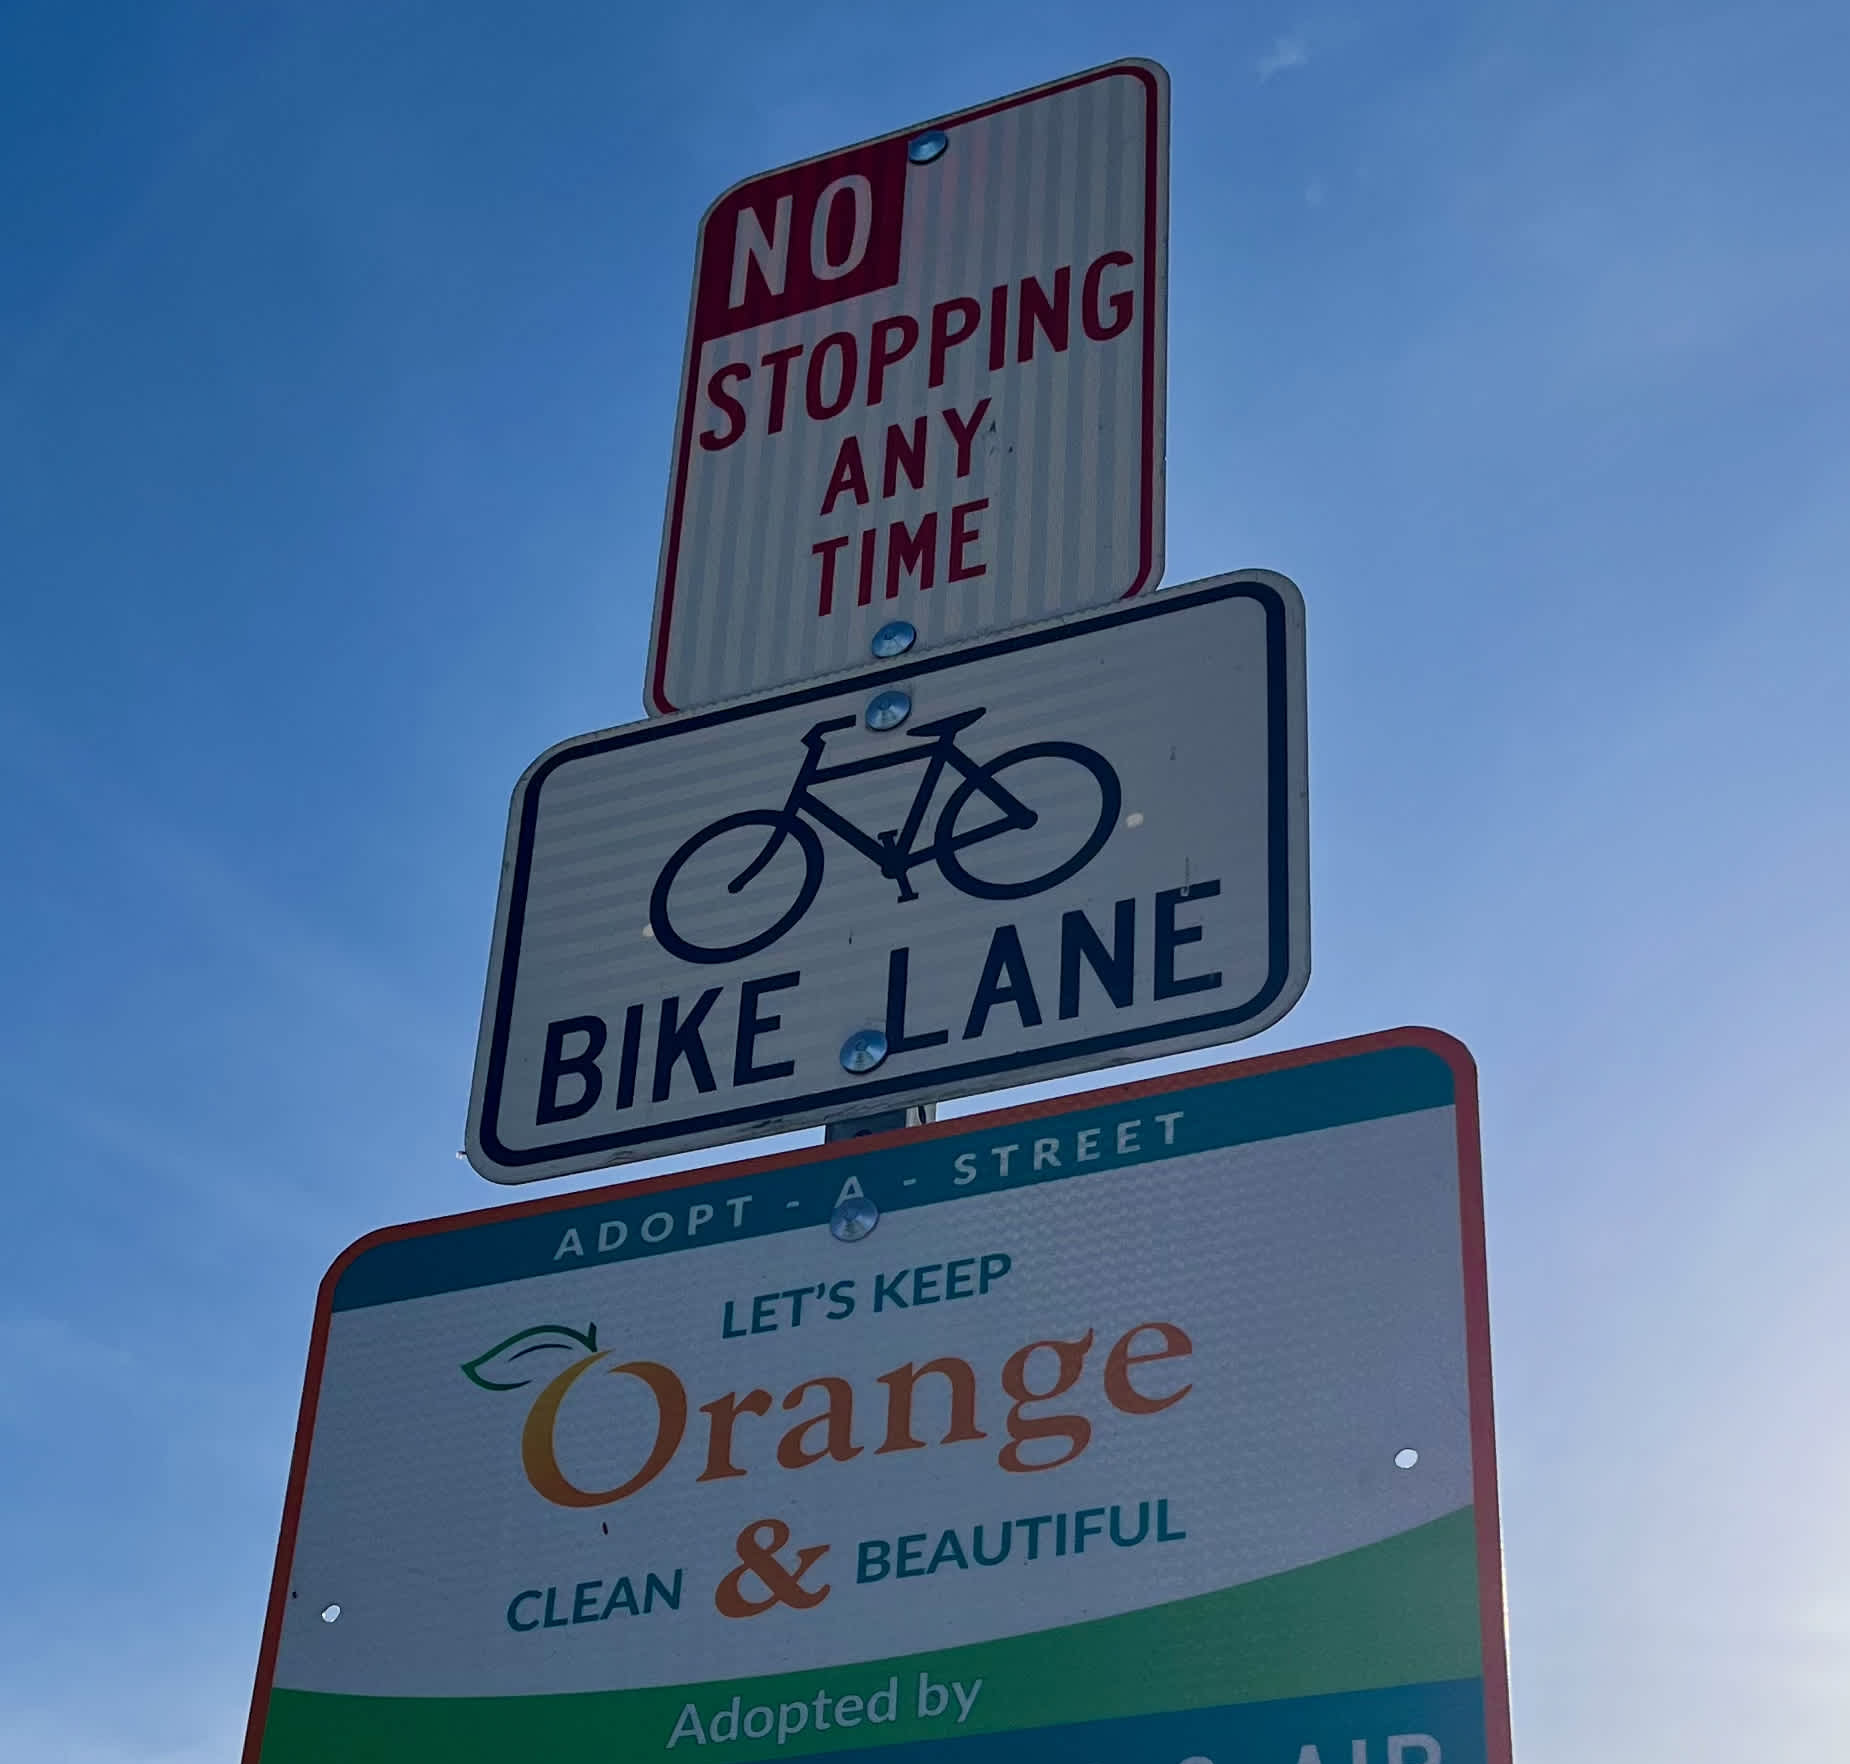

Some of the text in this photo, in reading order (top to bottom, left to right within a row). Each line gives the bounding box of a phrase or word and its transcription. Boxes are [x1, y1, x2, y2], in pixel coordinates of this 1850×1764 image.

[728, 174, 873, 310] NO
[699, 251, 1134, 451] STOPPING
[820, 397, 992, 516] ANY
[812, 498, 989, 617] TIME
[536, 879, 1222, 1126] BIKE LANE
[553, 1194, 754, 1260] ADOPT
[833, 1175, 866, 1210] A
[953, 1111, 1186, 1185] STREET
[721, 1252, 1012, 1339] LET'S KEEP
[520, 1321, 1193, 1508] Orange
[506, 1498, 1187, 1632] CLEAN & BEAUTIFUL
[665, 1671, 983, 1749] Adopted by
